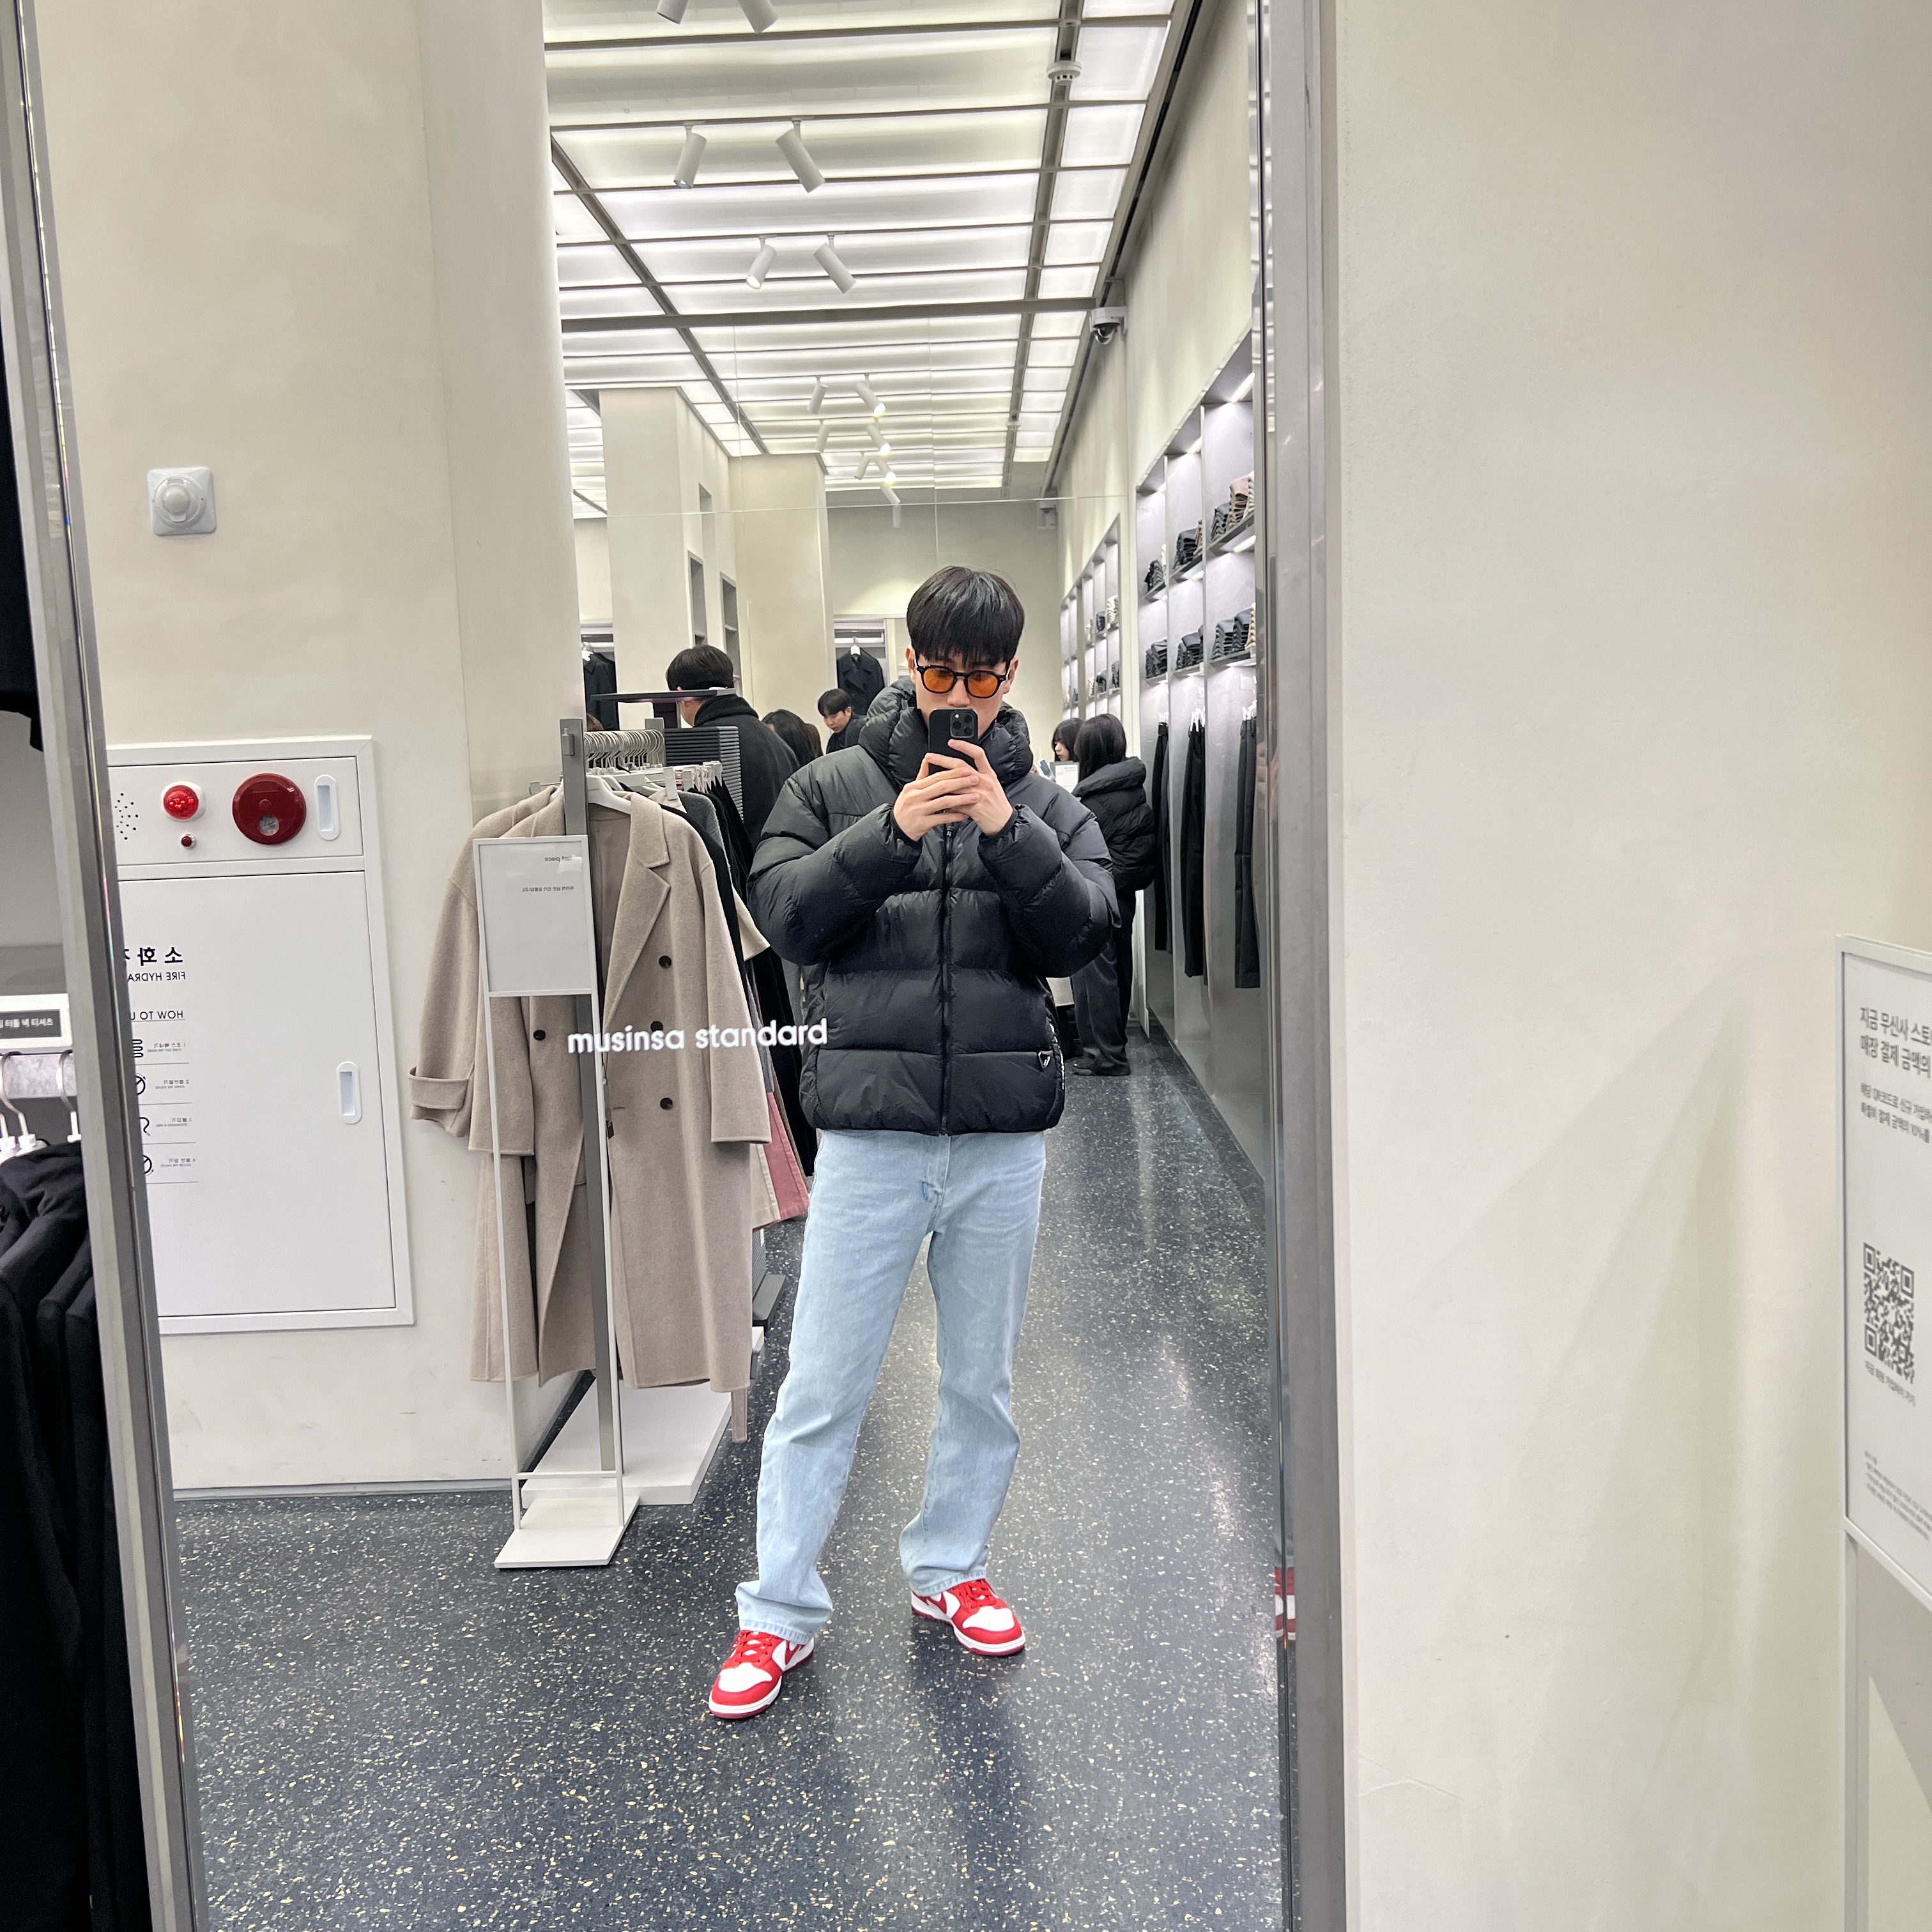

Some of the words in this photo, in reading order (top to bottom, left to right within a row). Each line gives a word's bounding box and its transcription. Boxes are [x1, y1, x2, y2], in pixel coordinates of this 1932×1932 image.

[567, 1025, 685, 1053] musinsa
[695, 1018, 829, 1048] standard
[1860, 1007, 1878, 1031] 지금
[1880, 1013, 1908, 1041] 무신사
[1860, 1035, 1878, 1058] 매장
[1880, 1041, 1899, 1067] 결제
[1901, 1048, 1931, 1078] 금액의
